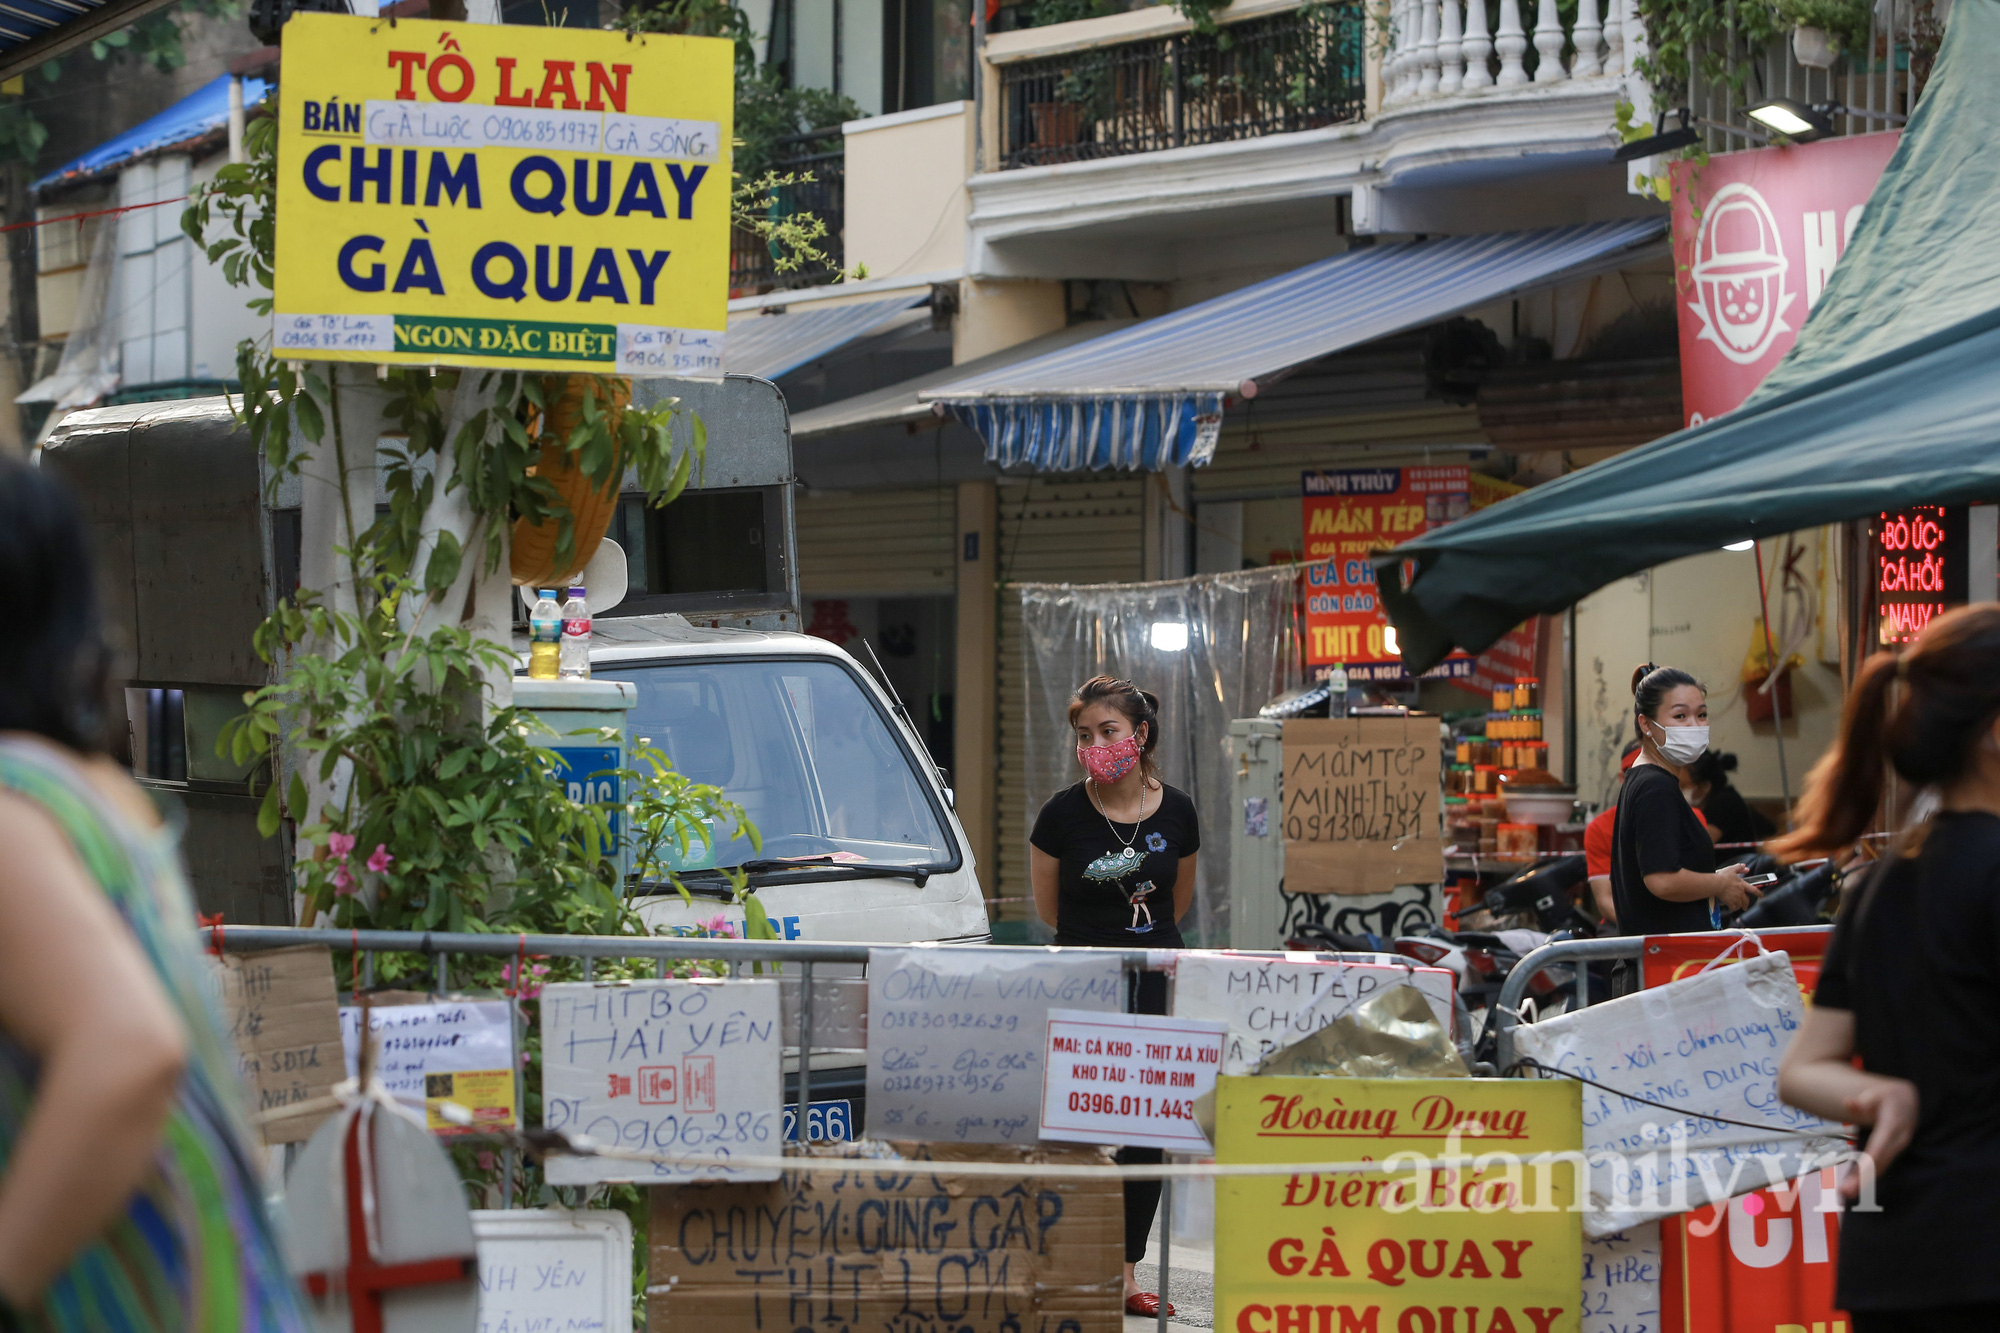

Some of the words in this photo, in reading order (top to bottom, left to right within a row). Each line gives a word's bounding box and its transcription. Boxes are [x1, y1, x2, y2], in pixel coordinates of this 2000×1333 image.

[388, 32, 475, 103] TỐ
[494, 57, 632, 113] LAN
[303, 96, 361, 134] BÁN
[483, 113, 600, 145] 0906851977
[604, 113, 639, 152] GÀ
[303, 144, 482, 209] CHIM
[510, 155, 709, 220] QUAY
[337, 218, 446, 295] GÀ
[471, 241, 671, 305] QUAY
[394, 325, 473, 348] NGON
[479, 324, 542, 354] ĐẶC
[548, 327, 616, 358] BIỆT
[1884, 514, 1910, 550] BÒ
[1911, 514, 1939, 550] ÚC
[1888, 603, 1934, 632] NAUY
[1052, 1036, 1081, 1054] MAI:
[1085, 1036, 1102, 1055] CÁ
[1106, 1041, 1132, 1058] KHO
[1145, 1043, 1172, 1064] THỊT
[1071, 1064, 1098, 1081] KHO
[1102, 1064, 1126, 1083] TÀU
[1170, 1071, 1196, 1088] RIM
[1068, 1091, 1193, 1120] 0396.011.443
[1260, 1094, 1399, 1139] Hoàng
[1412, 1095, 1529, 1140] Dung
[1268, 1226, 1352, 1278] GÀ
[1366, 1239, 1534, 1287] QUAY
[1236, 1304, 1381, 1333] CHIM
[1397, 1305, 1564, 1333] QUAY
